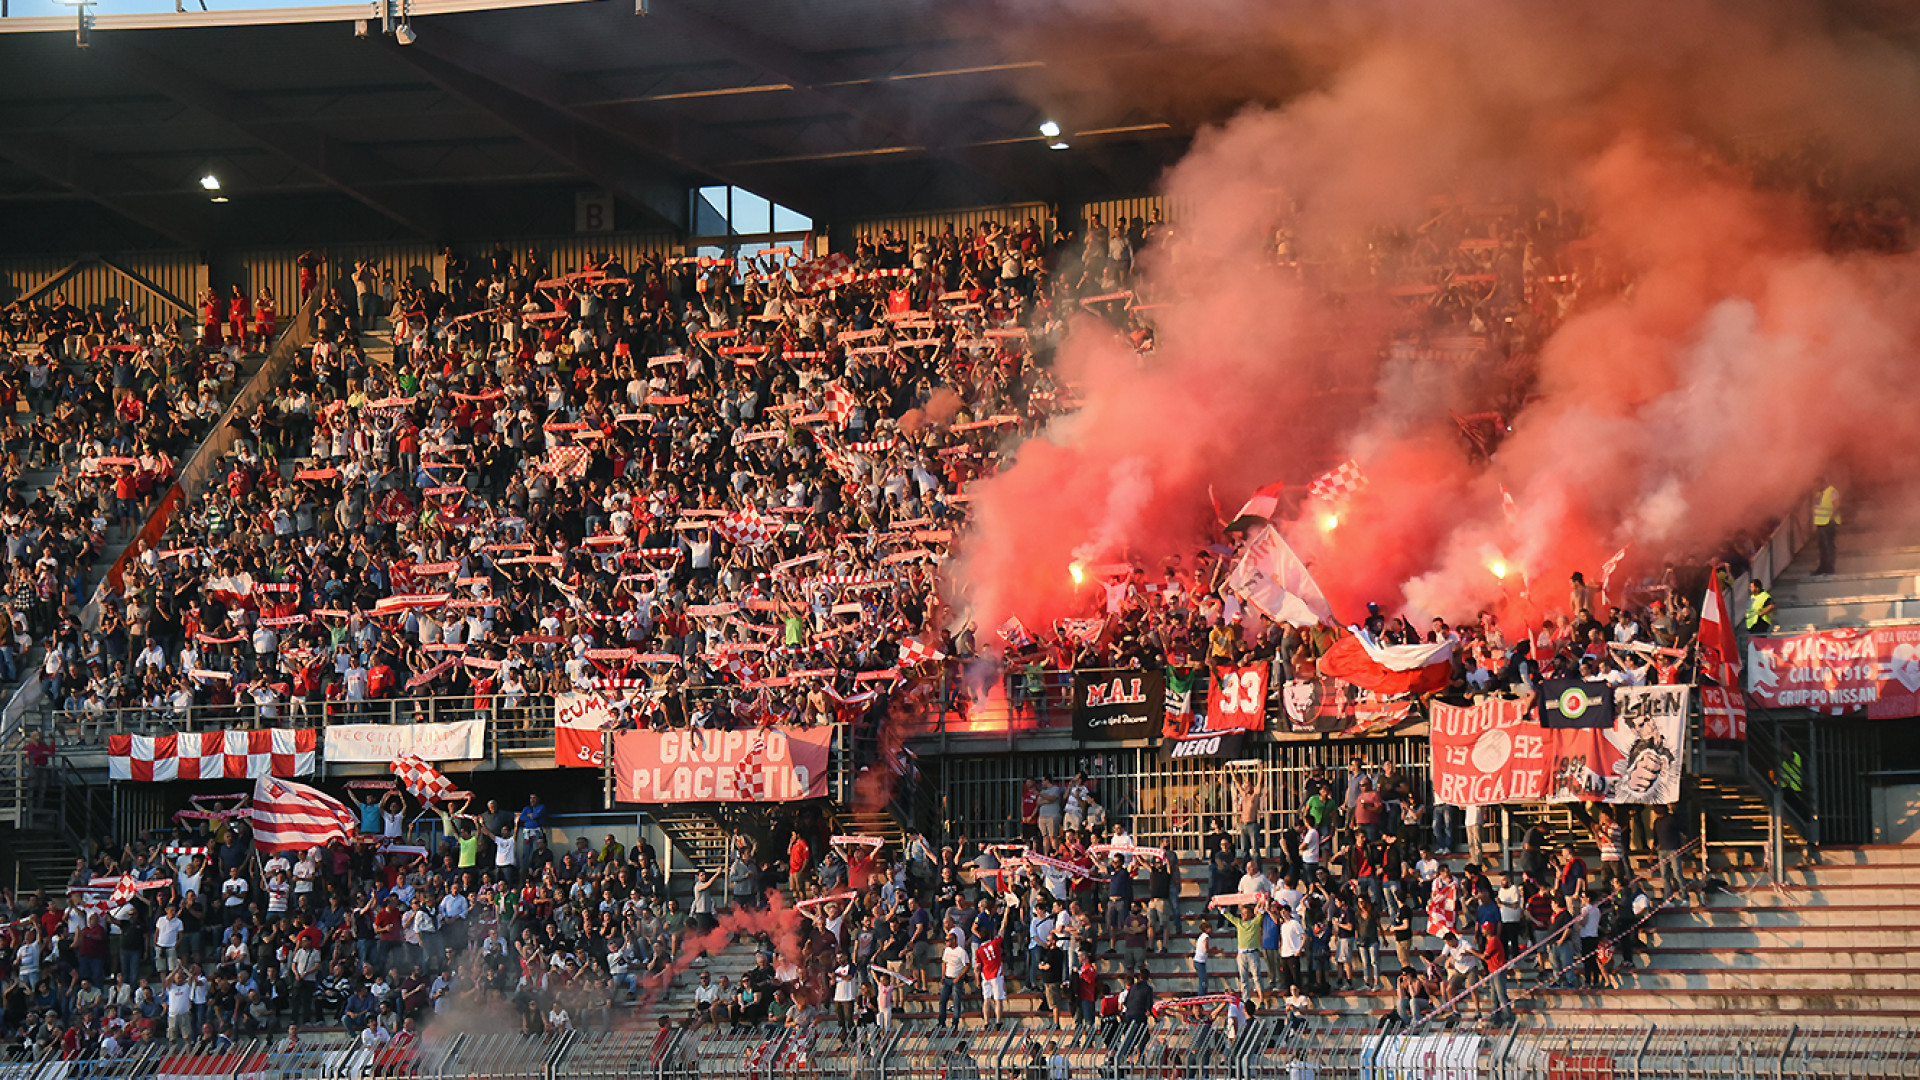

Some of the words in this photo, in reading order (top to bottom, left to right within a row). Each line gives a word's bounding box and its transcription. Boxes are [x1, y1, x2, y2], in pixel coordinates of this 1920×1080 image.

[586, 203, 603, 230] B
[1782, 635, 1875, 661] PIACENZA
[1789, 666, 1832, 683] CALCIO
[1836, 664, 1872, 682] 1919
[1219, 671, 1261, 714] 33
[1778, 689, 1827, 706] GRUPPO
[1829, 686, 1876, 704] NISSAN
[1171, 736, 1222, 758] NERO
[1514, 735, 1544, 759] 92
[632, 765, 810, 799] PLACETIA
[1441, 769, 1543, 804] BRIGADE
